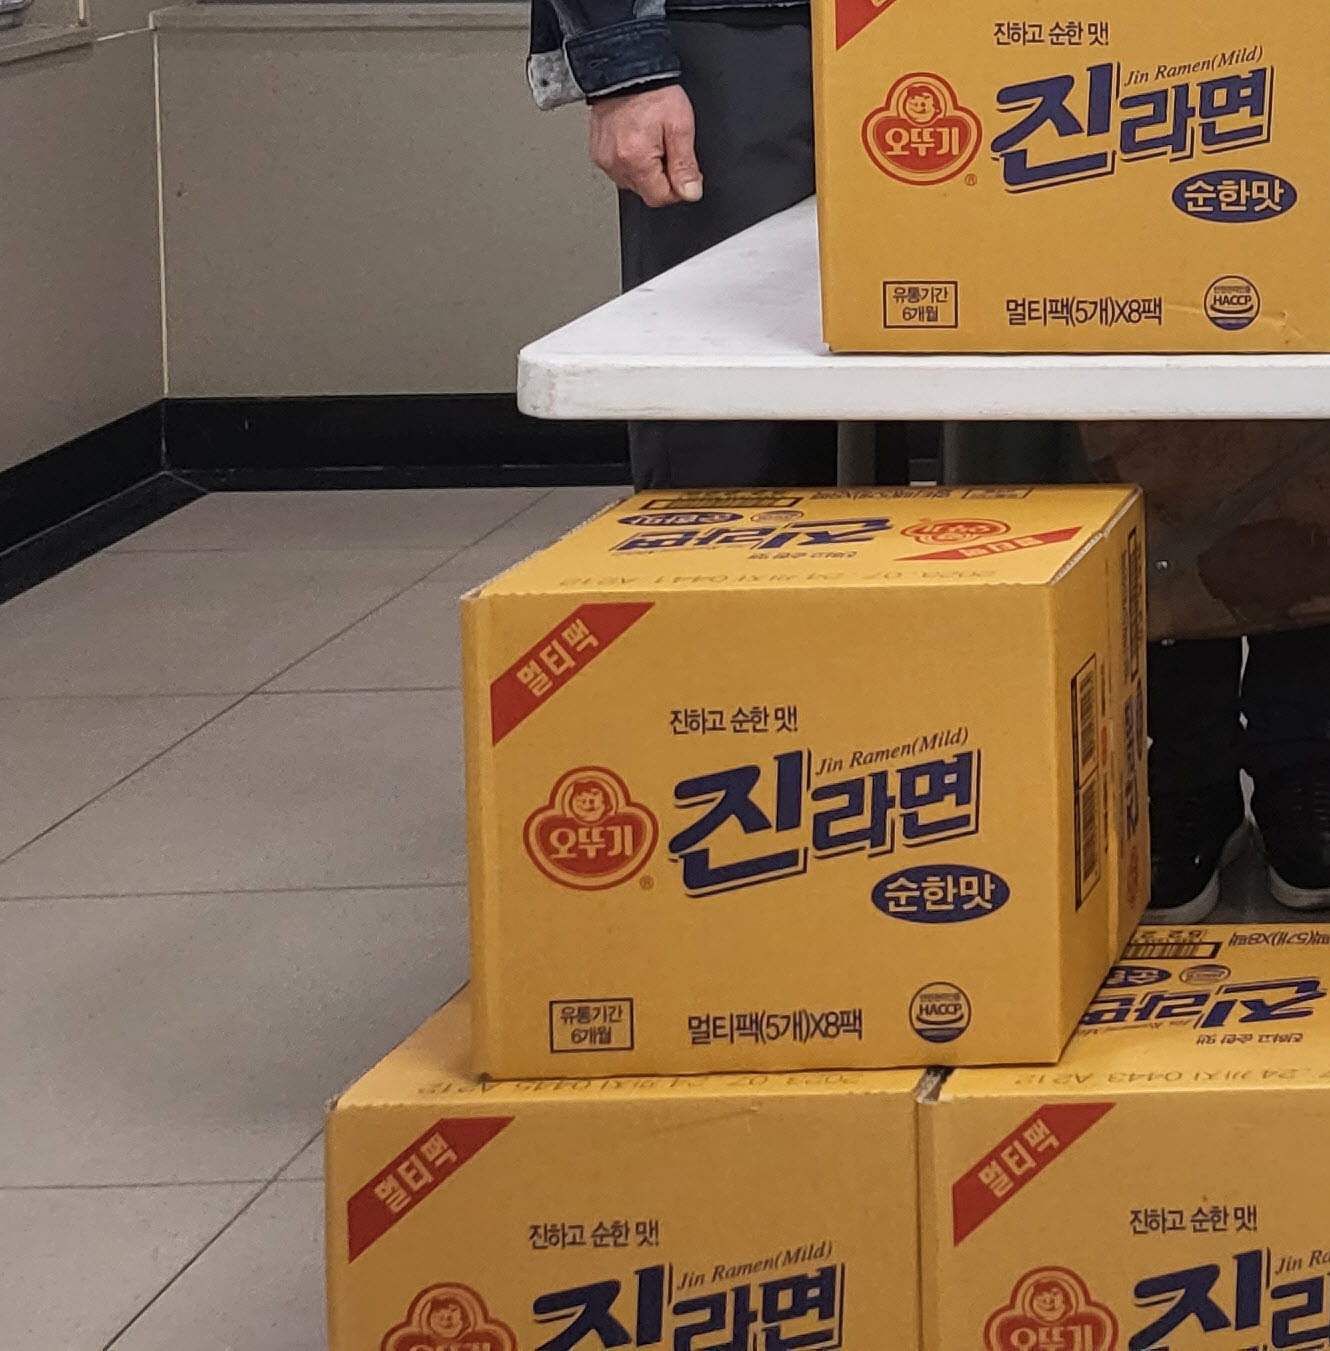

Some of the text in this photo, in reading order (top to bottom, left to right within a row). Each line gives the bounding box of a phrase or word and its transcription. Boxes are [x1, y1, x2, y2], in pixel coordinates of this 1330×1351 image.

[994, 21, 1045, 45] 진하고
[1049, 21, 1083, 45] 순한
[1124, 45, 1264, 87] Jin Ramen(Mild)
[885, 129, 960, 157] 오뚜기
[991, 62, 1274, 194] 진라면
[1183, 179, 1283, 213] 순한맛
[892, 287, 949, 304] 유통기간
[1213, 295, 1252, 305] HACCP
[902, 305, 939, 322] 6개월
[610, 516, 893, 551] 진라면
[516, 619, 599, 698] 멀티팩
[670, 708, 726, 735] 진하고
[730, 707, 769, 733] 순한
[815, 727, 969, 775] Jin Ramen(Mild)
[668, 748, 981, 898] 진라면
[549, 827, 634, 859] 오뚜기
[885, 874, 996, 911] 순한맛
[560, 1005, 626, 1025] 유통기간
[919, 1004, 962, 1015] HACCP
[571, 1025, 612, 1045] 6개월
[374, 1133, 458, 1214] 멀티팩
[976, 1120, 1060, 1198] 멀티팩
[529, 1223, 586, 1249] 진하고
[591, 1220, 630, 1248] 순한
[1130, 1208, 1186, 1234] 진하고
[1190, 1206, 1229, 1233] 순한
[677, 1240, 832, 1290] Jin Ramen(Mild)
[1275, 1256, 1302, 1275] Jin
